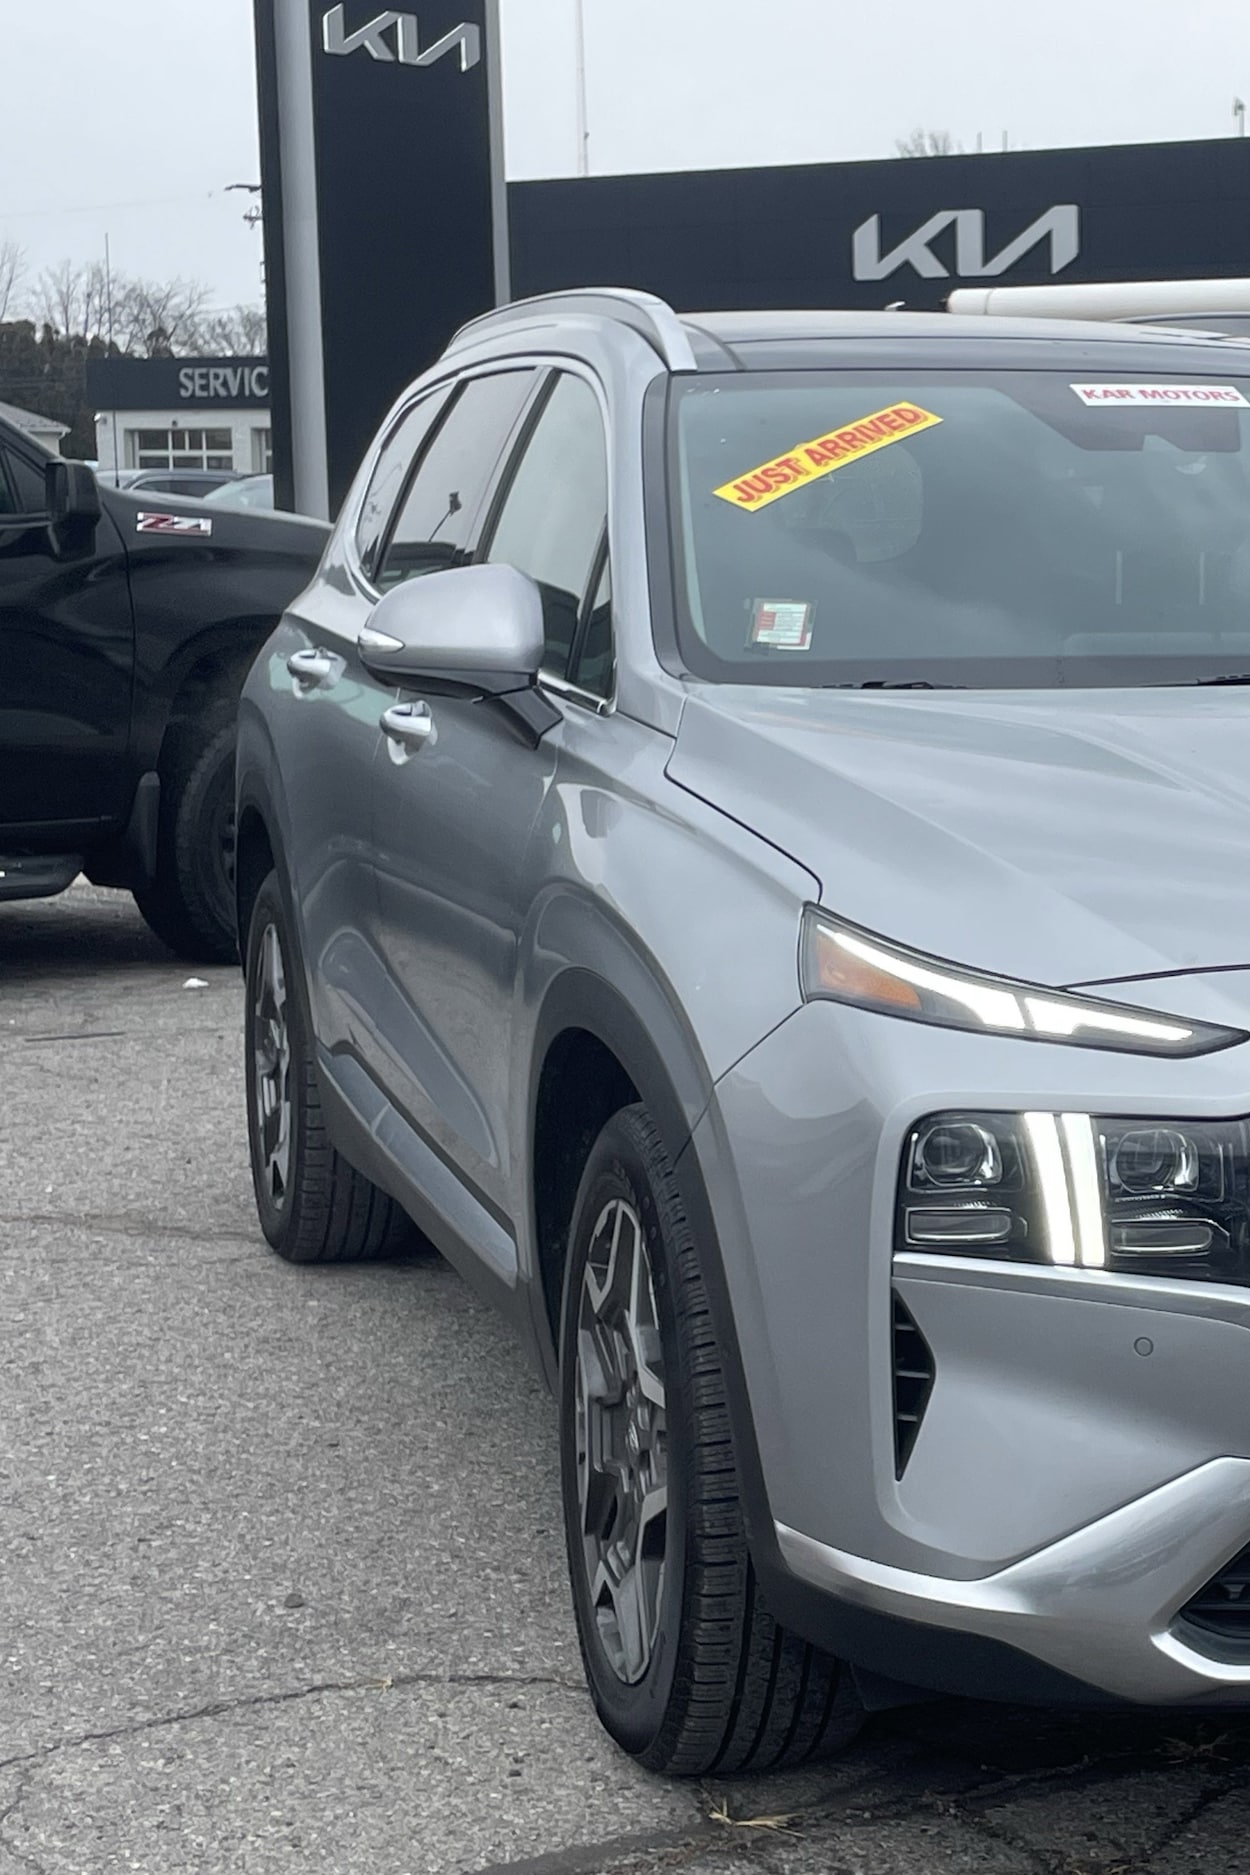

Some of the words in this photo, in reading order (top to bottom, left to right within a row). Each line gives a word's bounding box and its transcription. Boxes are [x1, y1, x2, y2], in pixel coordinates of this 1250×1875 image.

[323, 2, 480, 73] KIA
[853, 203, 1079, 281] KIA
[179, 366, 269, 398] SERVIC
[1081, 388, 1136, 400] KAR
[1137, 388, 1242, 402] MOTORS
[732, 456, 811, 504] JUST
[803, 407, 927, 468] ARRIVED
